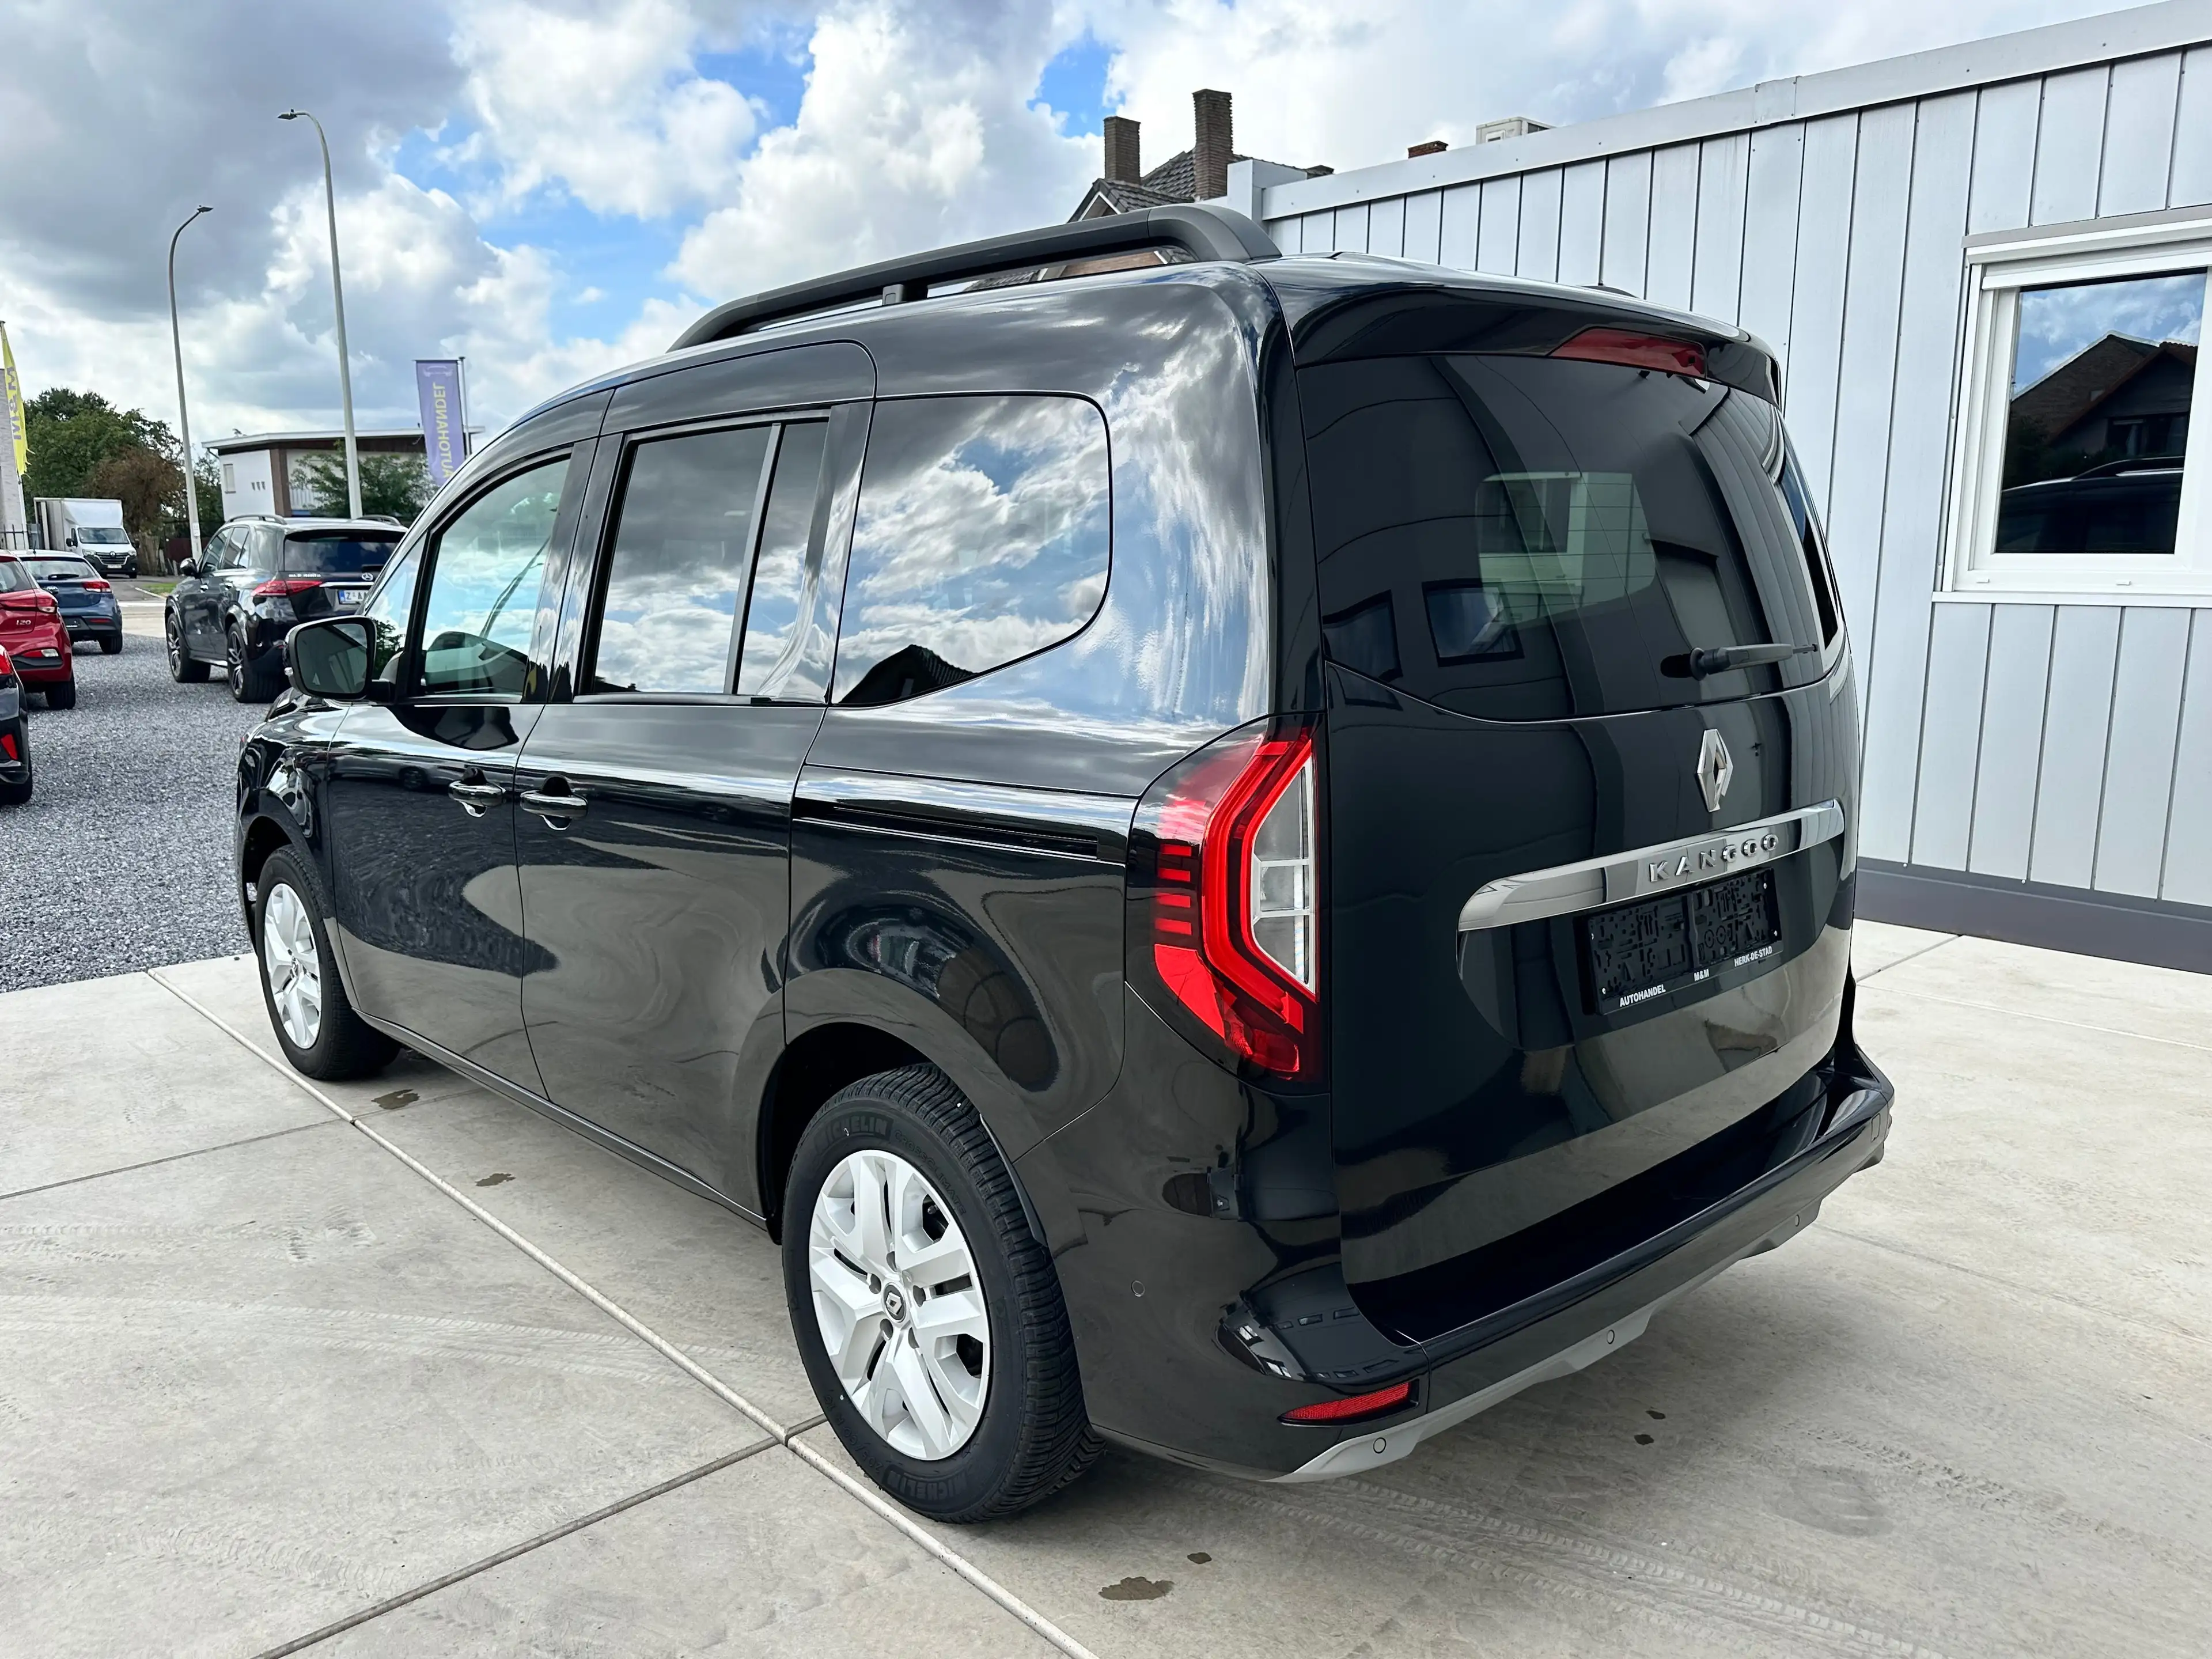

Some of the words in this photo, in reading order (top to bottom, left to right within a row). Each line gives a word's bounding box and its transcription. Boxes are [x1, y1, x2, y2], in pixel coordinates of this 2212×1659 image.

[1649, 834, 1778, 882] KANGOO
[1620, 984, 1666, 1007] AUTOHANDEL
[1694, 969, 1709, 982] M&M
[1734, 946, 1772, 967] HERK-DE-STAD
[887, 1469, 968, 1501] MICHELIN
